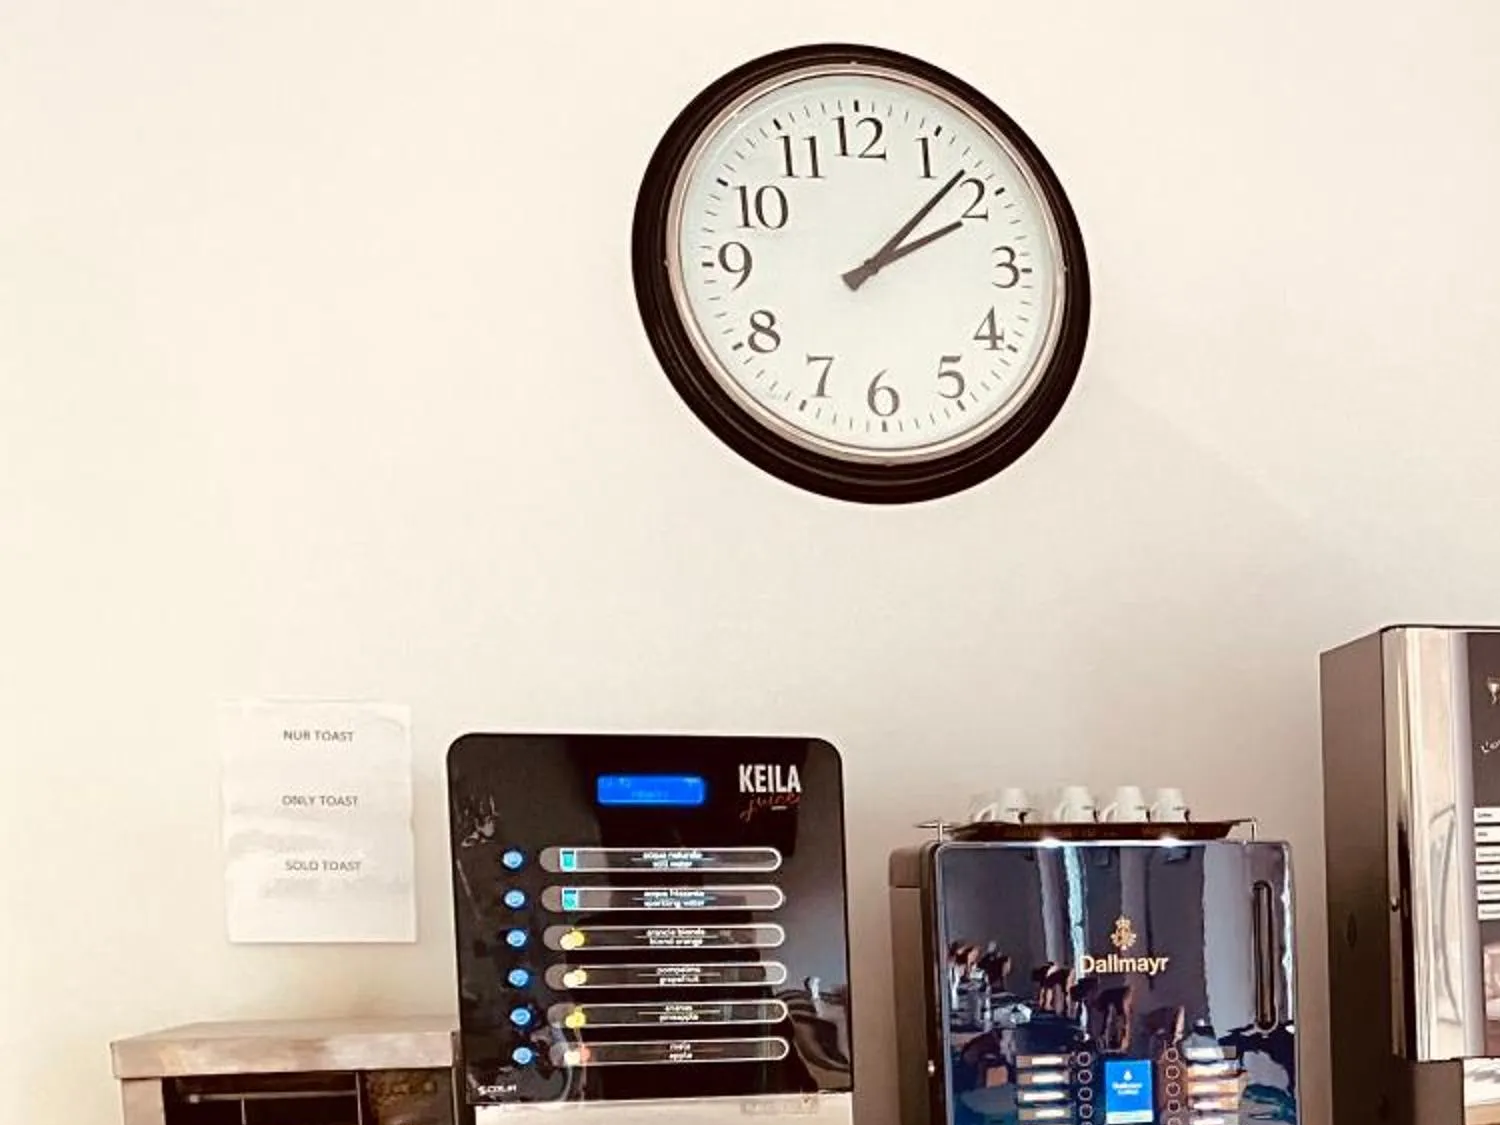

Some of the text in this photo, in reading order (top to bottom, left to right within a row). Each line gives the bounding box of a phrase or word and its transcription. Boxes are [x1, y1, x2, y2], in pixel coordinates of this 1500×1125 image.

[780, 135, 826, 179] 11
[833, 115, 887, 160] 12
[916, 137, 938, 179] 1
[735, 184, 789, 230] 10
[958, 177, 989, 220] 2
[718, 241, 753, 290] 9
[992, 245, 1021, 289] 3
[747, 309, 781, 353] 8
[973, 305, 1005, 351] 4
[806, 353, 835, 398] 7
[866, 369, 900, 416] 6
[937, 355, 965, 399] 5
[283, 729, 354, 742] NUR TOAST
[738, 764, 801, 793] KEILA
[281, 795, 358, 807] ONLY TOAST
[322, 860, 361, 872] TOAST
[1080, 953, 1169, 976] Dallmayr
